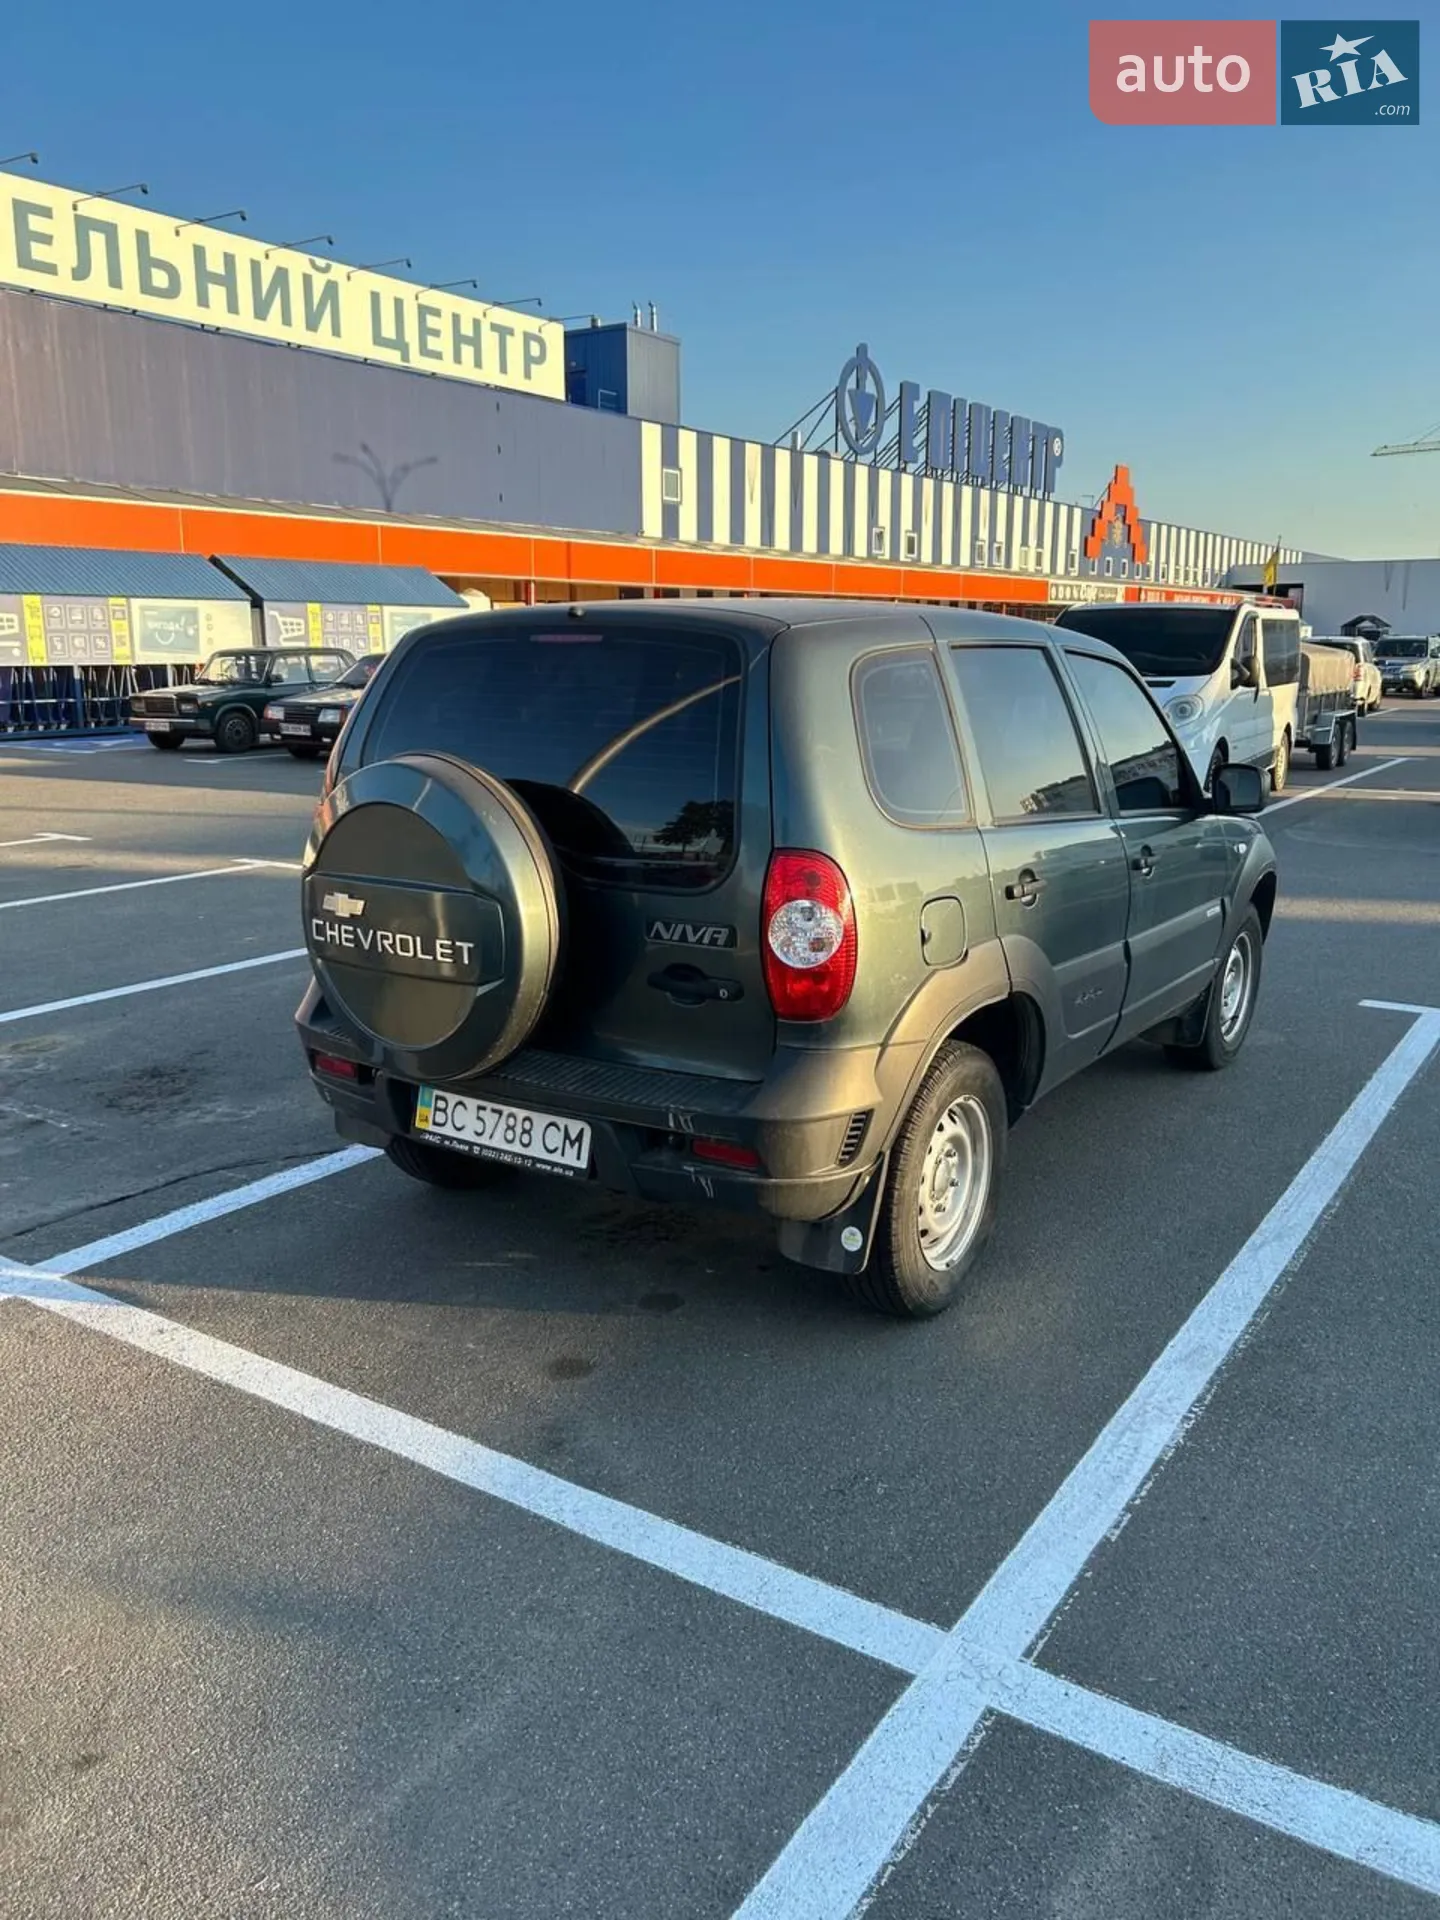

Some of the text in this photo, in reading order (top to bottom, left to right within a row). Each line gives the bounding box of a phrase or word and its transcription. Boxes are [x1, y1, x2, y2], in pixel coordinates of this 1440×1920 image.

[12, 197, 548, 380] ЕЛЬНИЙ ЦЕНТР
[311, 918, 475, 965] CHEVROLET
[650, 921, 729, 946] NIVA
[432, 1095, 585, 1161] BC 5788 CM
